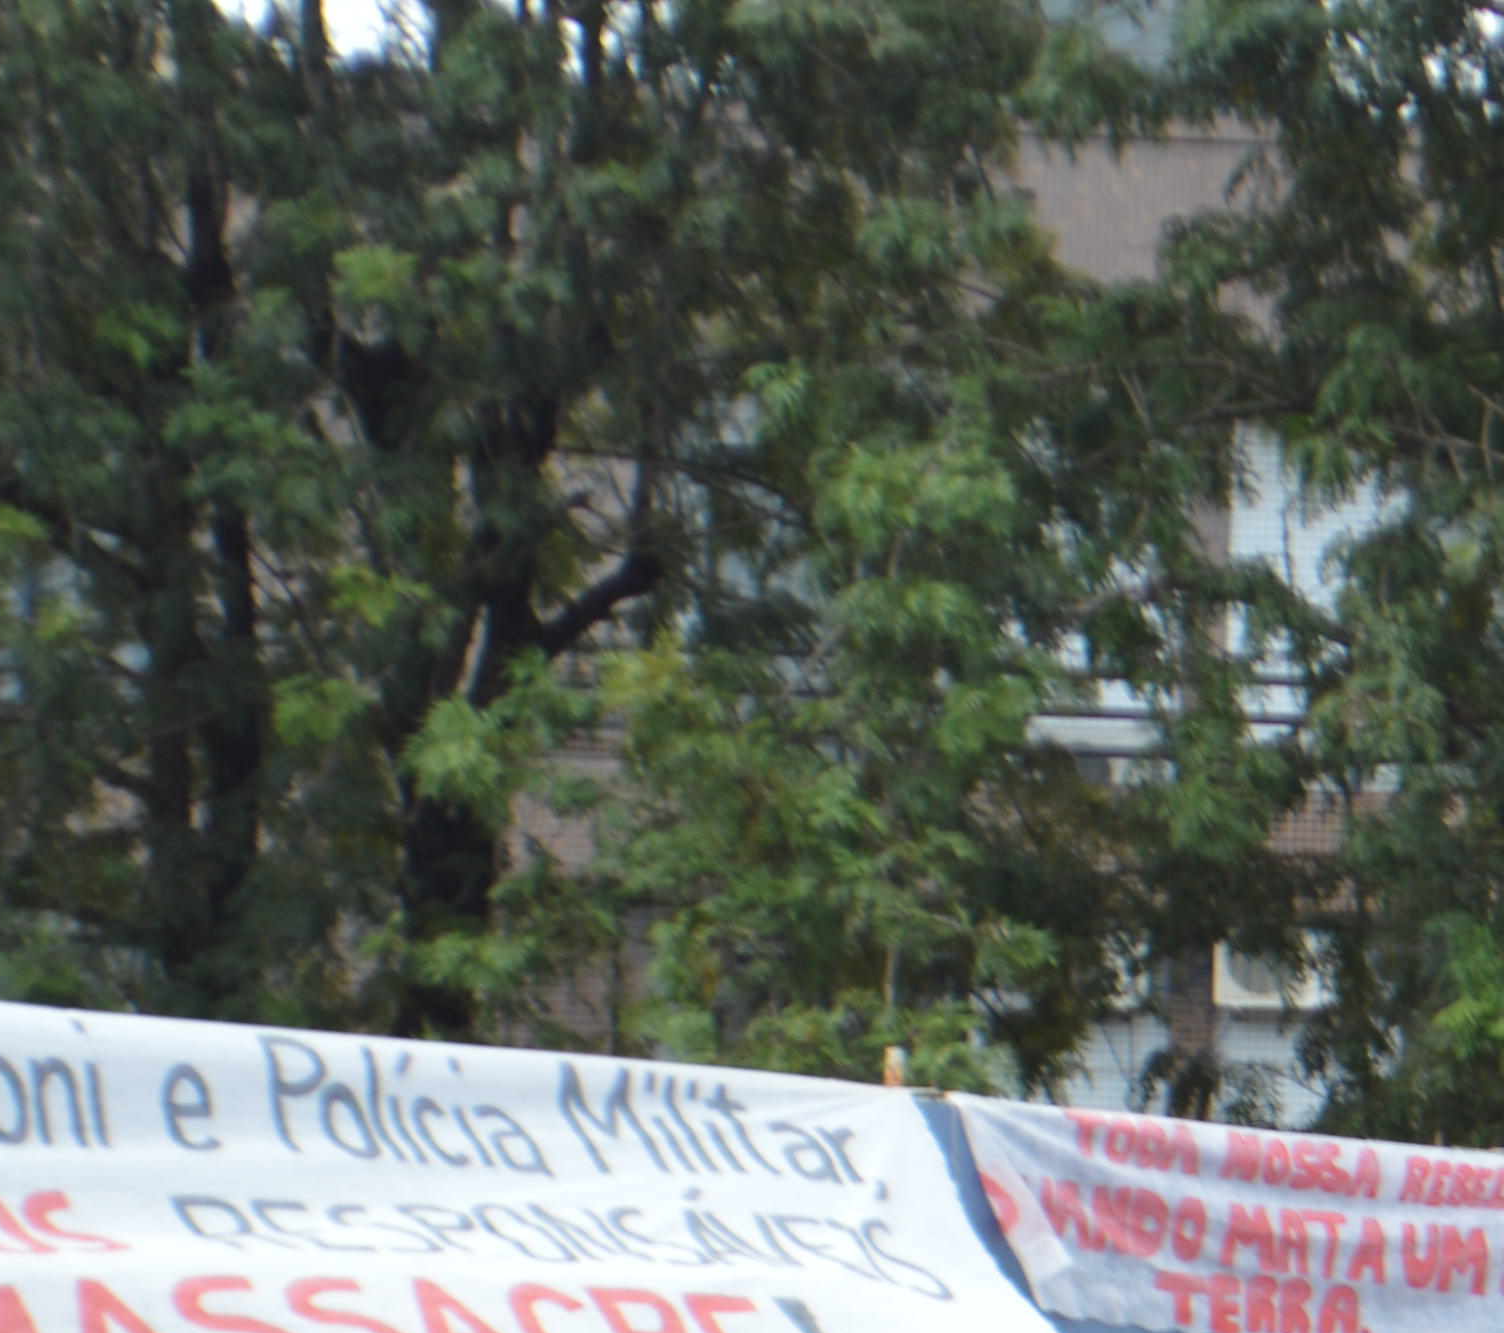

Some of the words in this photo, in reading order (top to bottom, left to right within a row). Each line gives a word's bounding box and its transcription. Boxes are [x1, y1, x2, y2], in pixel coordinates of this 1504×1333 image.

[162, 1060, 223, 1152] e
[256, 1033, 556, 1178] Polícia
[556, 1058, 890, 1200] Militar,
[1062, 1107, 1199, 1177] TODA
[1218, 1131, 1381, 1200] NOSSA
[1219, 1203, 1386, 1285] MATA
[1400, 1223, 1489, 1298] UM
